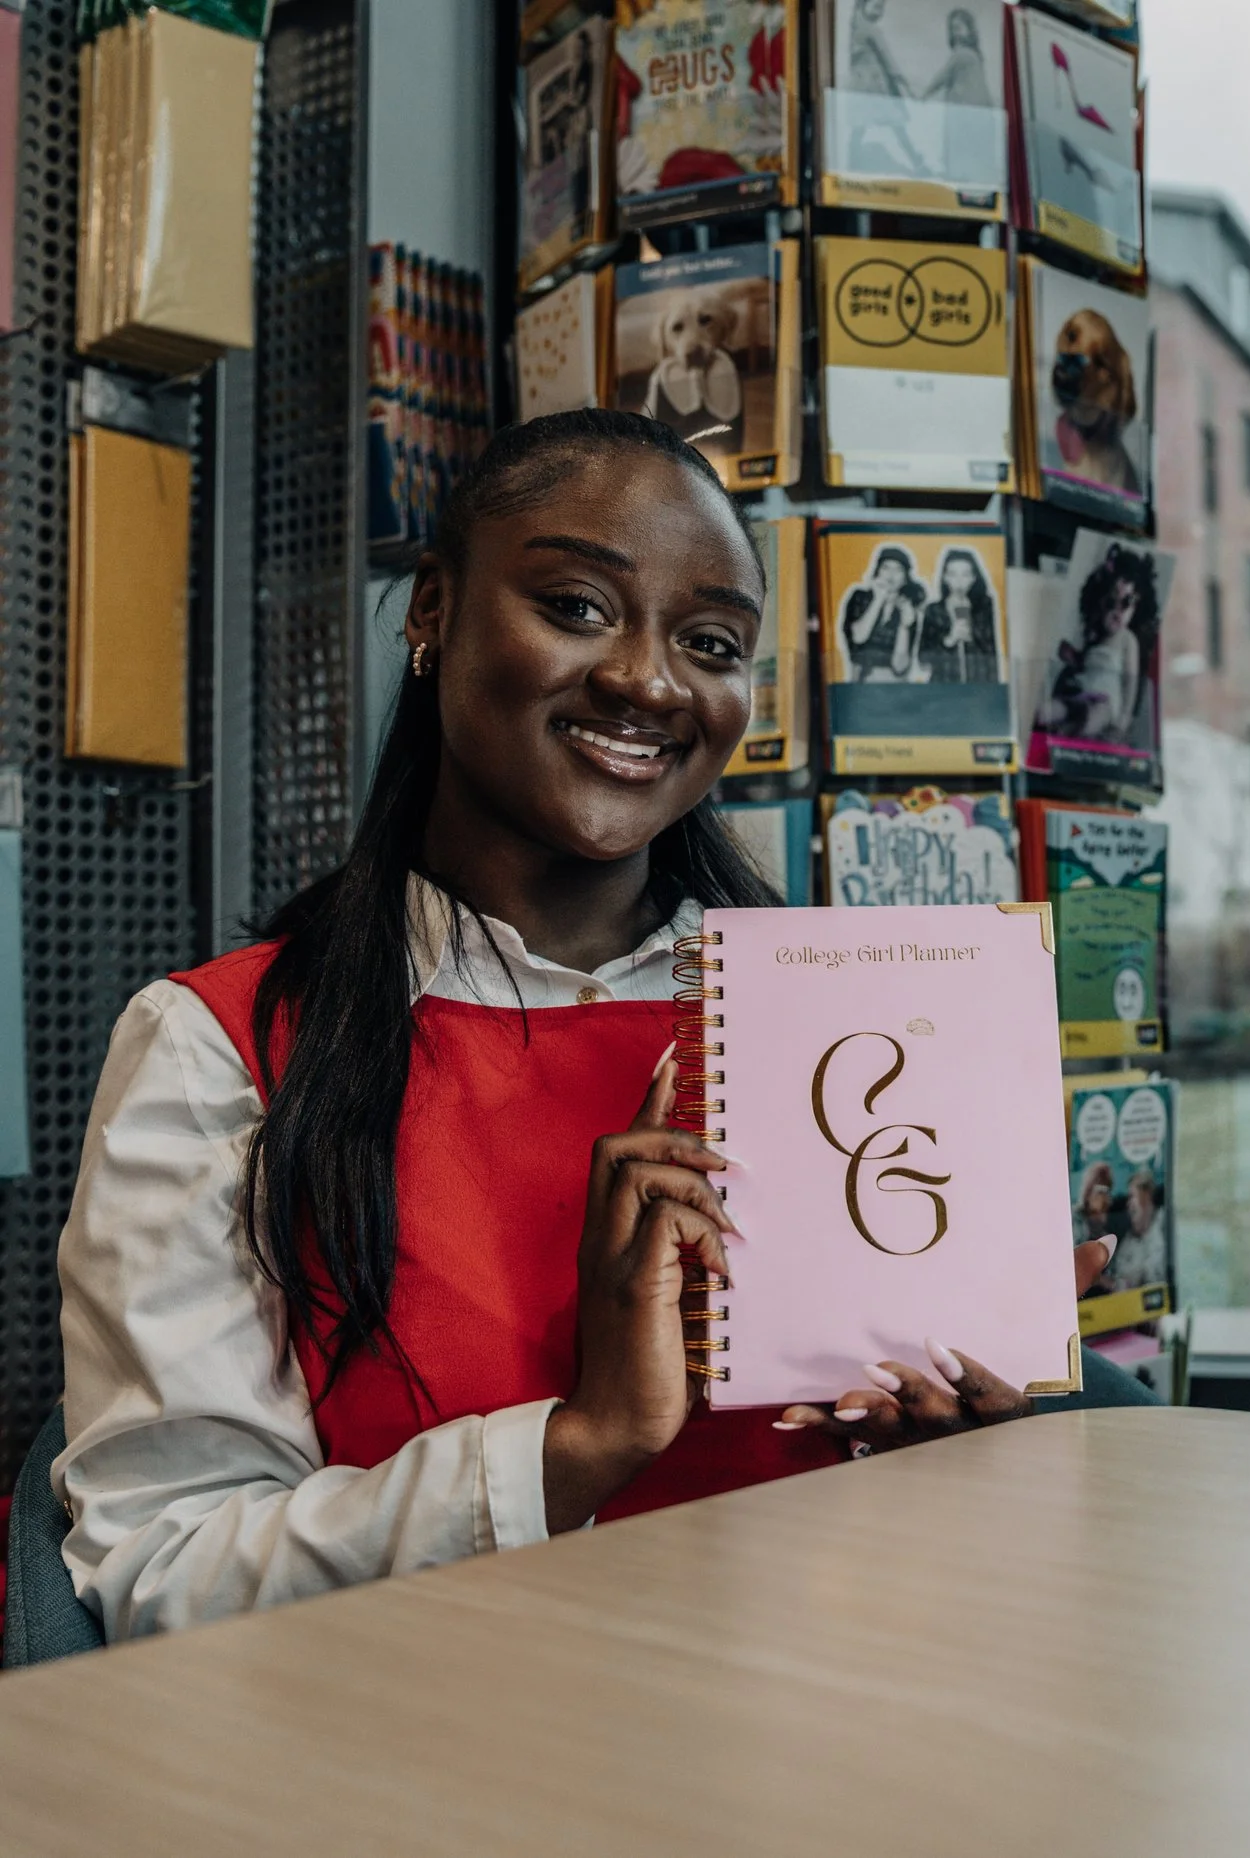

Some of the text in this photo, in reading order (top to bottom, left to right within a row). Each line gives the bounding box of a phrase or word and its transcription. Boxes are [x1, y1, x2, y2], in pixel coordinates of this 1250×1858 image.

[851, 284, 893, 298] good
[932, 289, 969, 306] bad
[850, 302, 889, 317] girls
[930, 309, 972, 327] girls
[776, 943, 981, 970] College Girl Planner
